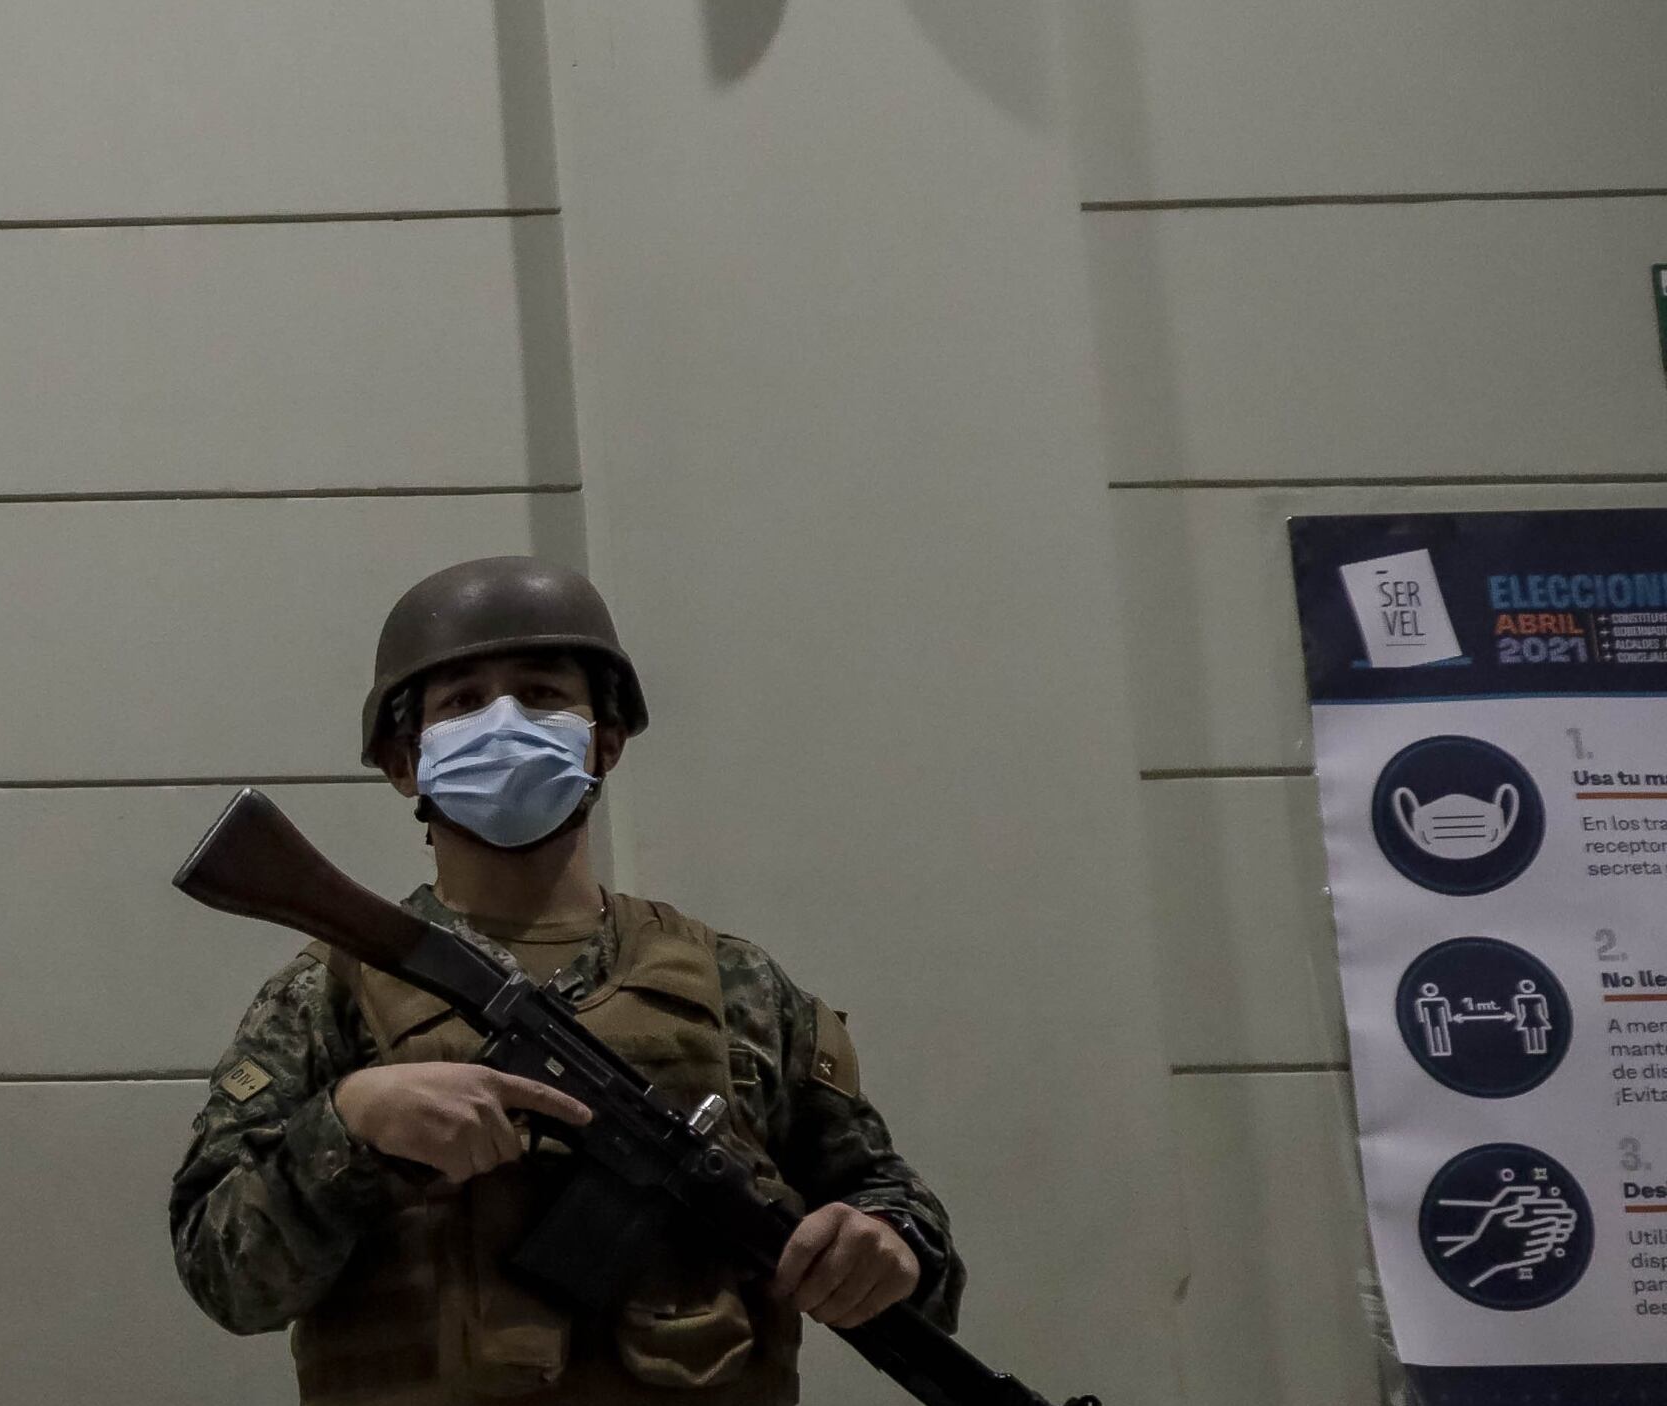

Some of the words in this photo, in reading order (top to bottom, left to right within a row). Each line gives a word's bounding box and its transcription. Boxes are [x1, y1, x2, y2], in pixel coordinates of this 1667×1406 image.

[1378, 581, 1422, 608] SER
[1488, 573, 1667, 610] ELECCION
[1381, 610, 1427, 637] VEL
[1494, 612, 1584, 635] ABRIL
[1498, 636, 1589, 664] 2021
[1573, 770, 1614, 786] Usa
[1617, 770, 1640, 786] tu
[1582, 816, 1607, 831] En
[1611, 815, 1640, 831] los
[1587, 861, 1663, 877] secreta
[1595, 928, 1629, 962] 2.
[1601, 972, 1635, 988] No
[1462, 997, 1474, 1011] 1
[1608, 1018, 1622, 1034] A
[1611, 1042, 1667, 1057] mant
[1612, 1064, 1637, 1080] de
[1618, 1137, 1652, 1171] 3.
